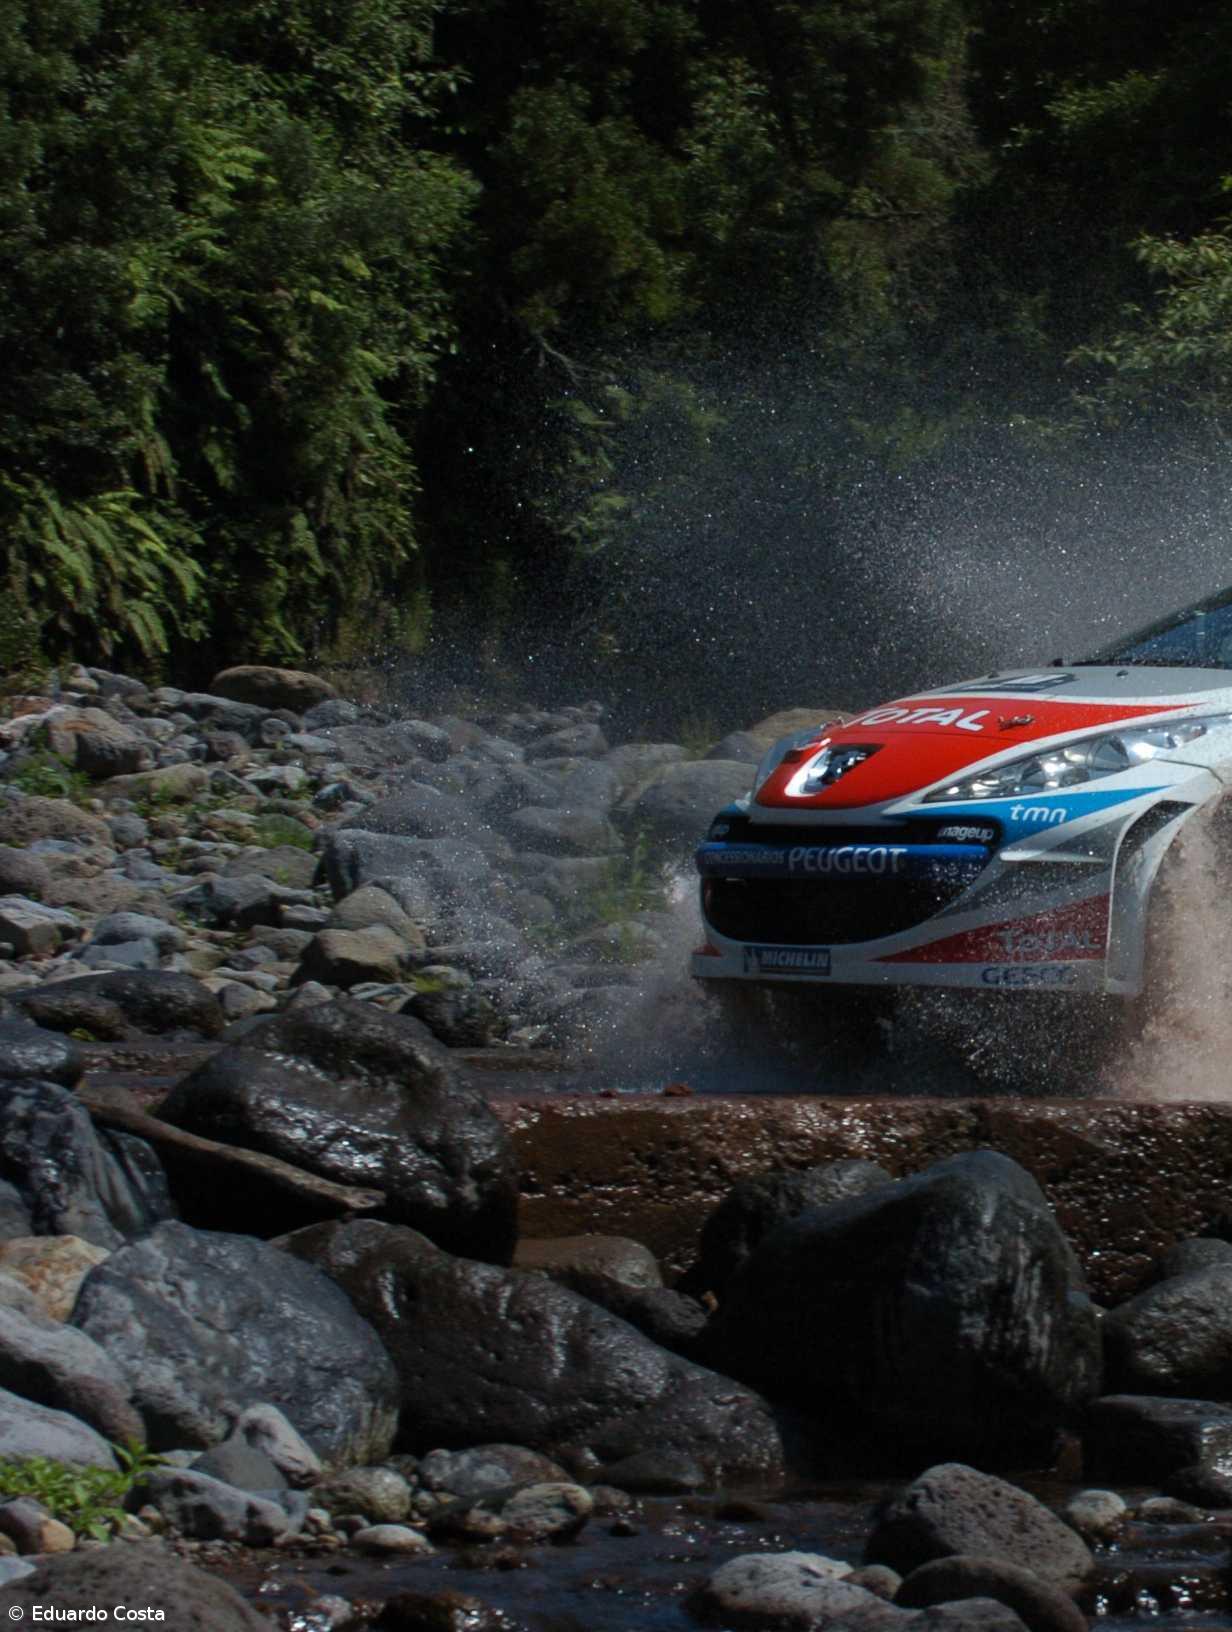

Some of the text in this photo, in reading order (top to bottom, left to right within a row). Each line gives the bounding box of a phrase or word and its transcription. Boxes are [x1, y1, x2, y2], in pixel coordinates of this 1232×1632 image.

[842, 707, 991, 732] TOTAL
[1010, 804, 1067, 823] tmn
[788, 847, 908, 873] PEUGEOT
[761, 951, 830, 969] MICHELIN
